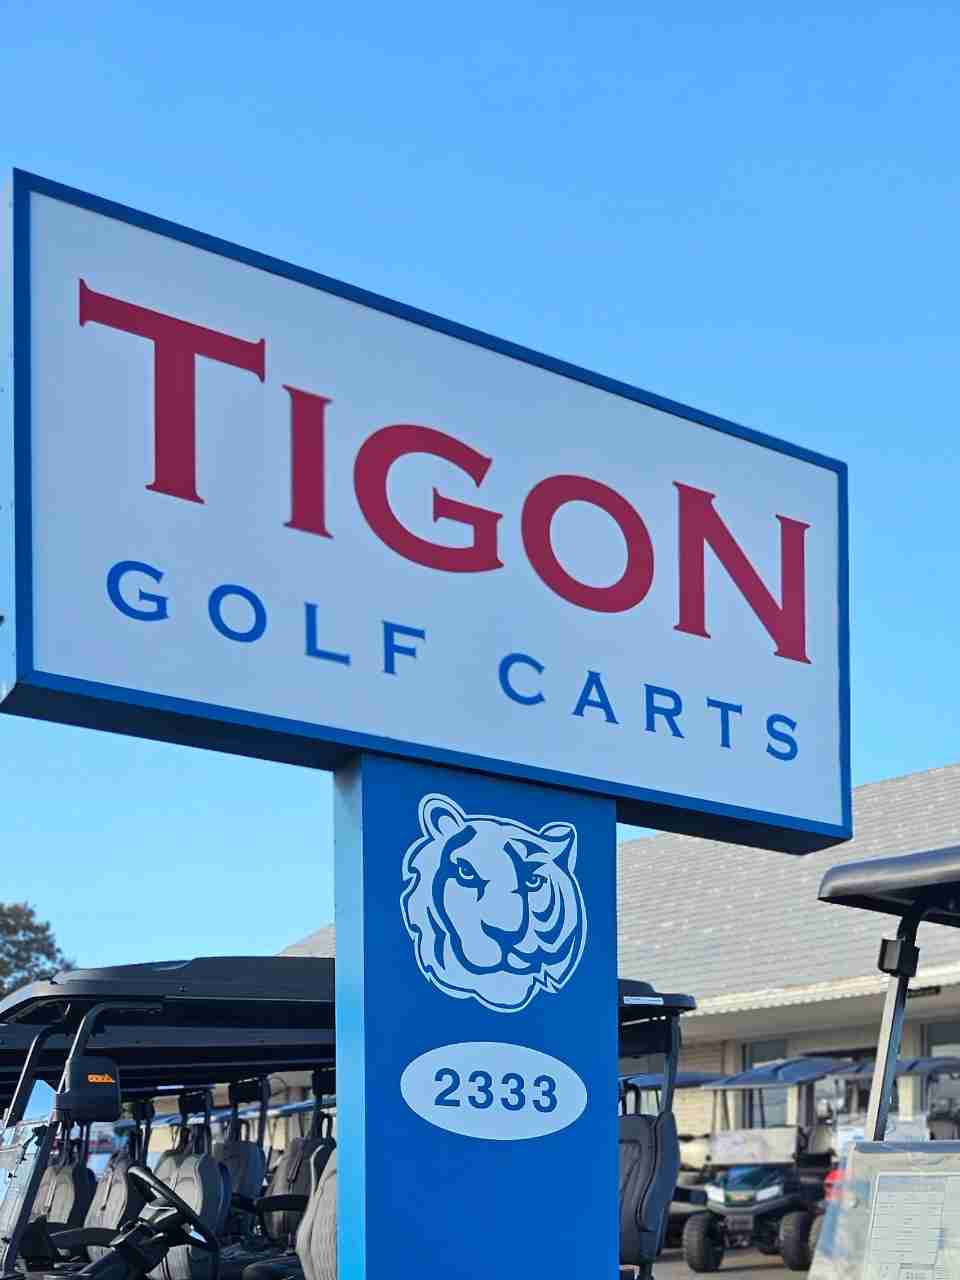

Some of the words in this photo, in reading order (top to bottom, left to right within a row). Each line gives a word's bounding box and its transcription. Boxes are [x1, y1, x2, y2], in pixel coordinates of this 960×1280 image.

[79, 278, 811, 664] TIGON
[105, 559, 427, 676] GOLF
[498, 652, 800, 763] CARTS
[434, 1067, 558, 1113] 2333
